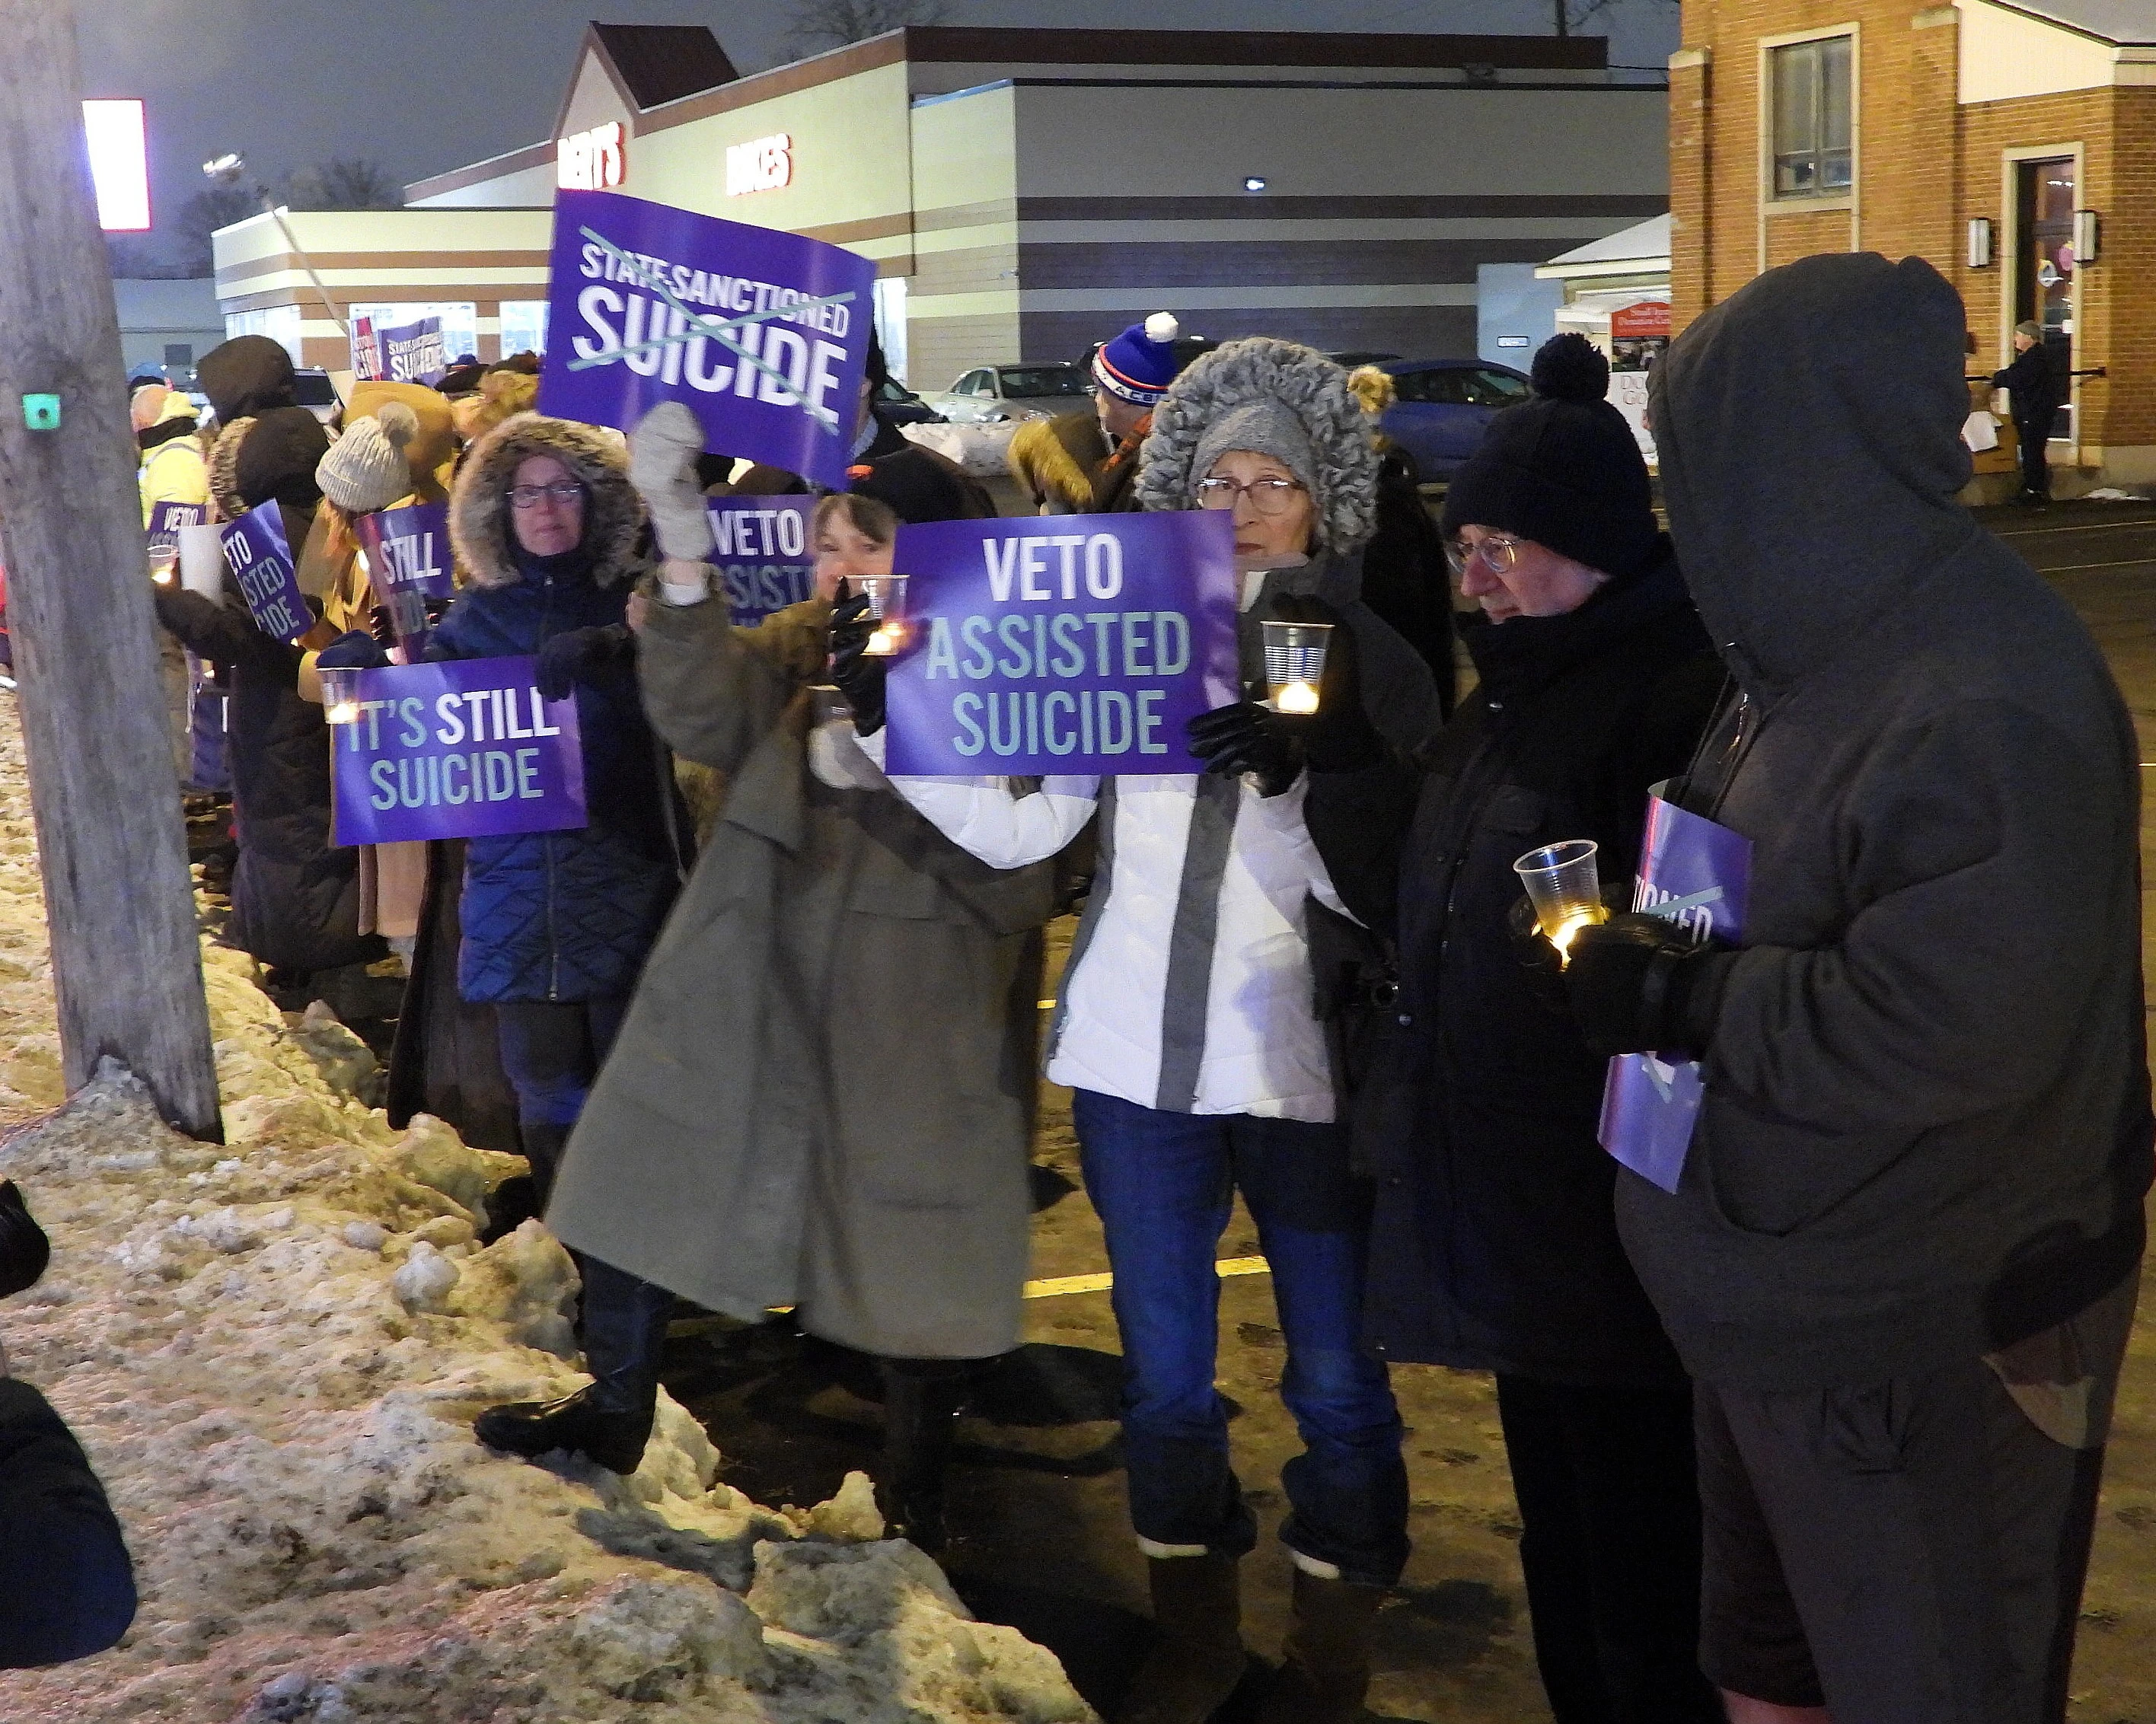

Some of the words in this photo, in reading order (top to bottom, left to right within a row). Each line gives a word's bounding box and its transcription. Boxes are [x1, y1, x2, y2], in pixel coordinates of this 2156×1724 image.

[572, 285, 847, 425] SUICIDE
[381, 533, 442, 585] STILL
[706, 509, 805, 556] VETO
[983, 533, 1124, 601] VETO
[925, 611, 1191, 680] ASSISTED
[349, 697, 428, 752] IT'S
[435, 687, 560, 744] STILL
[952, 690, 1168, 757] SUICIDE
[370, 747, 544, 811] SUICIDE
